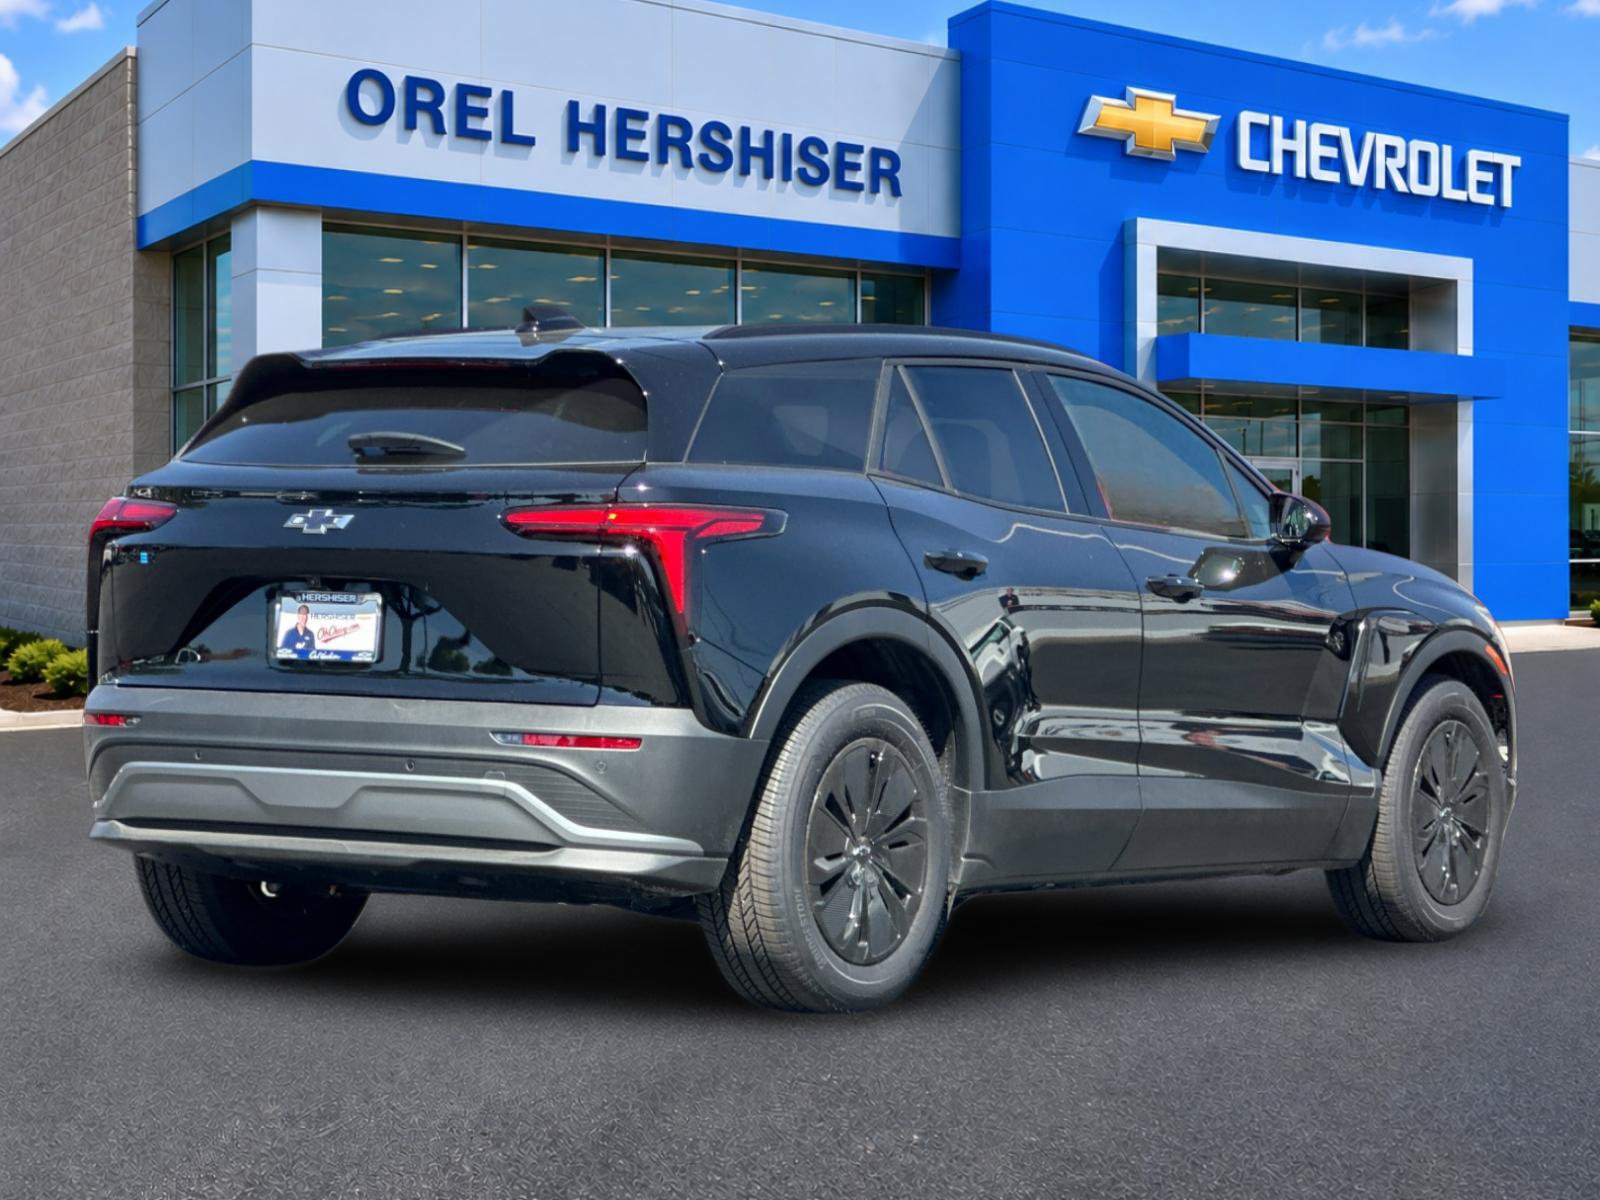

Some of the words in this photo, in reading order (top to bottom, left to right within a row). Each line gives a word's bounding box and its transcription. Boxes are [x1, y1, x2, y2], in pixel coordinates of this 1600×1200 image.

[346, 68, 536, 147] OREL
[566, 99, 903, 198] HERSHISER
[1236, 109, 1522, 208] CHEVROLET
[302, 592, 357, 603] HERSHISER
